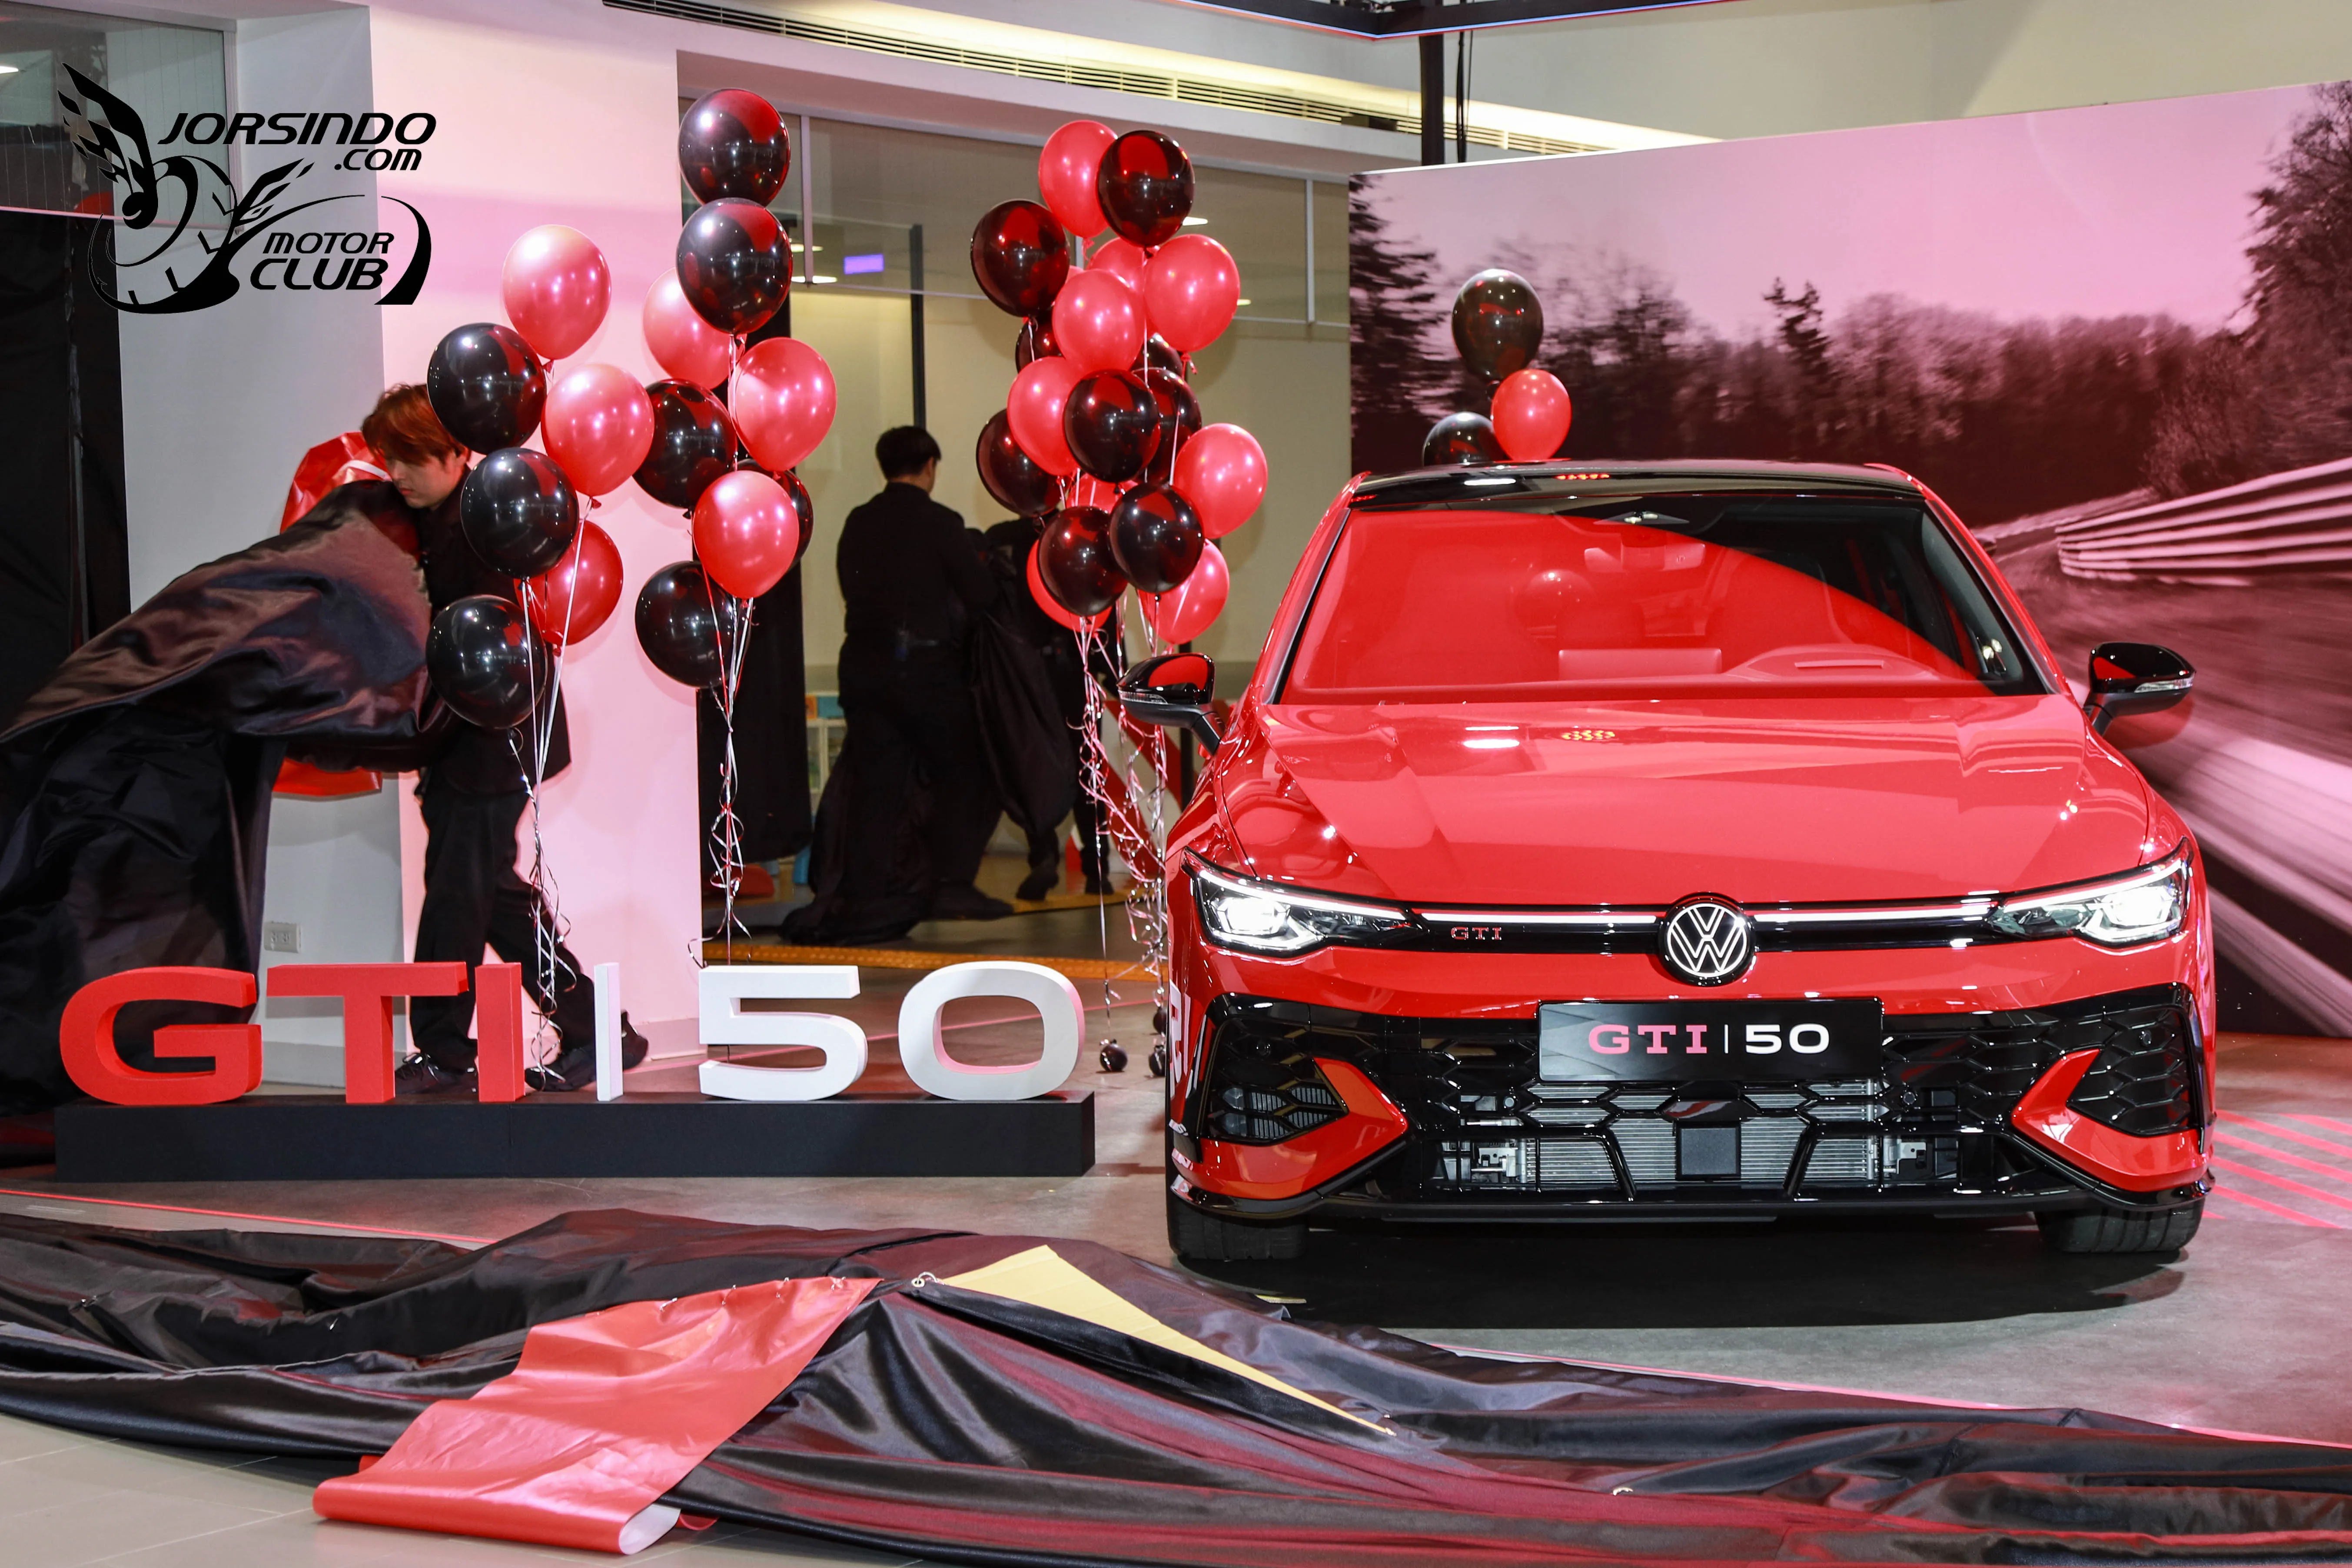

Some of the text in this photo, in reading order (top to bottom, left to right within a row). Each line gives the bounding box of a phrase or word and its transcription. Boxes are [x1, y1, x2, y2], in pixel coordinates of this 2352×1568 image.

[1450, 927, 1502, 941] GTI
[60, 962, 526, 1105] GTI
[698, 960, 1084, 1101] 50
[1588, 1024, 1830, 1054] GTI 50
